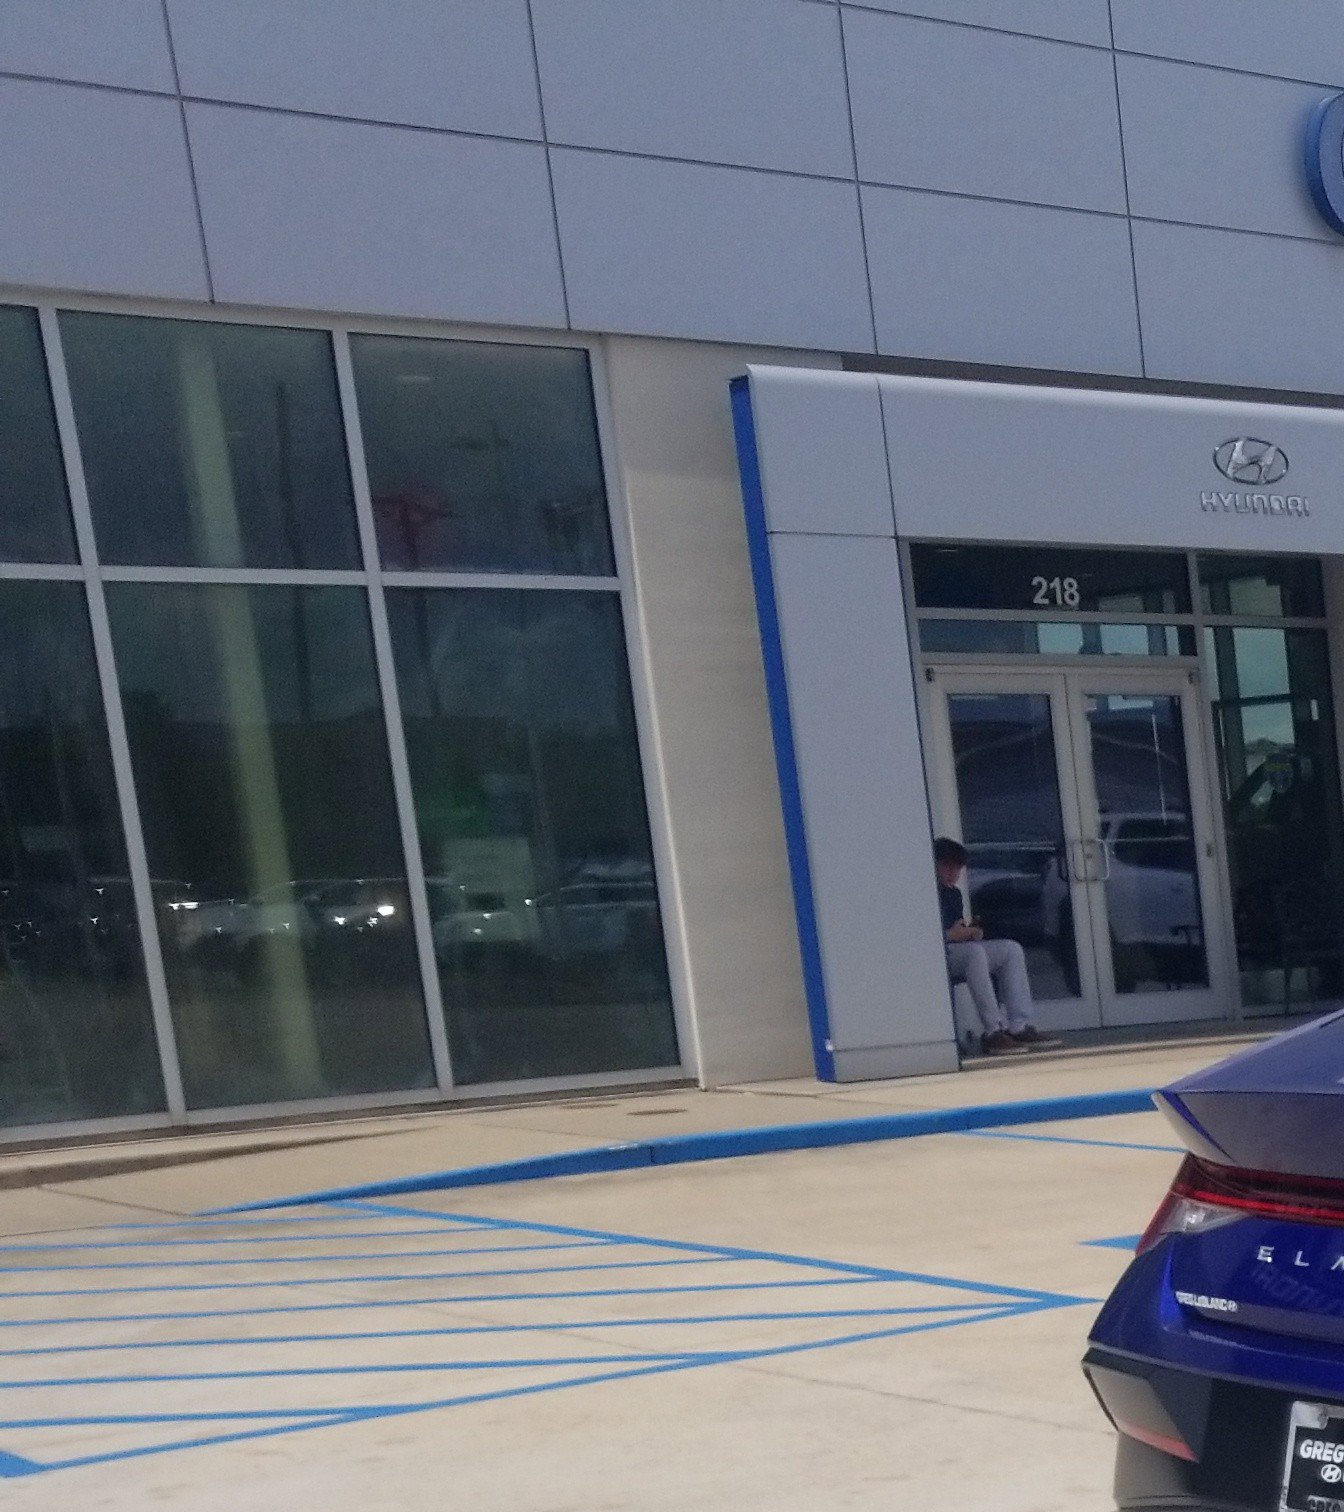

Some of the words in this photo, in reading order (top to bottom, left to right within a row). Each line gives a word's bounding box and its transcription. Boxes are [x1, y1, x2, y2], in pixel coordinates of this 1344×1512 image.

[1200, 490, 1311, 517] HYUNDAI
[1030, 576, 1080, 606] 218
[1300, 1439, 1344, 1463] GREG
